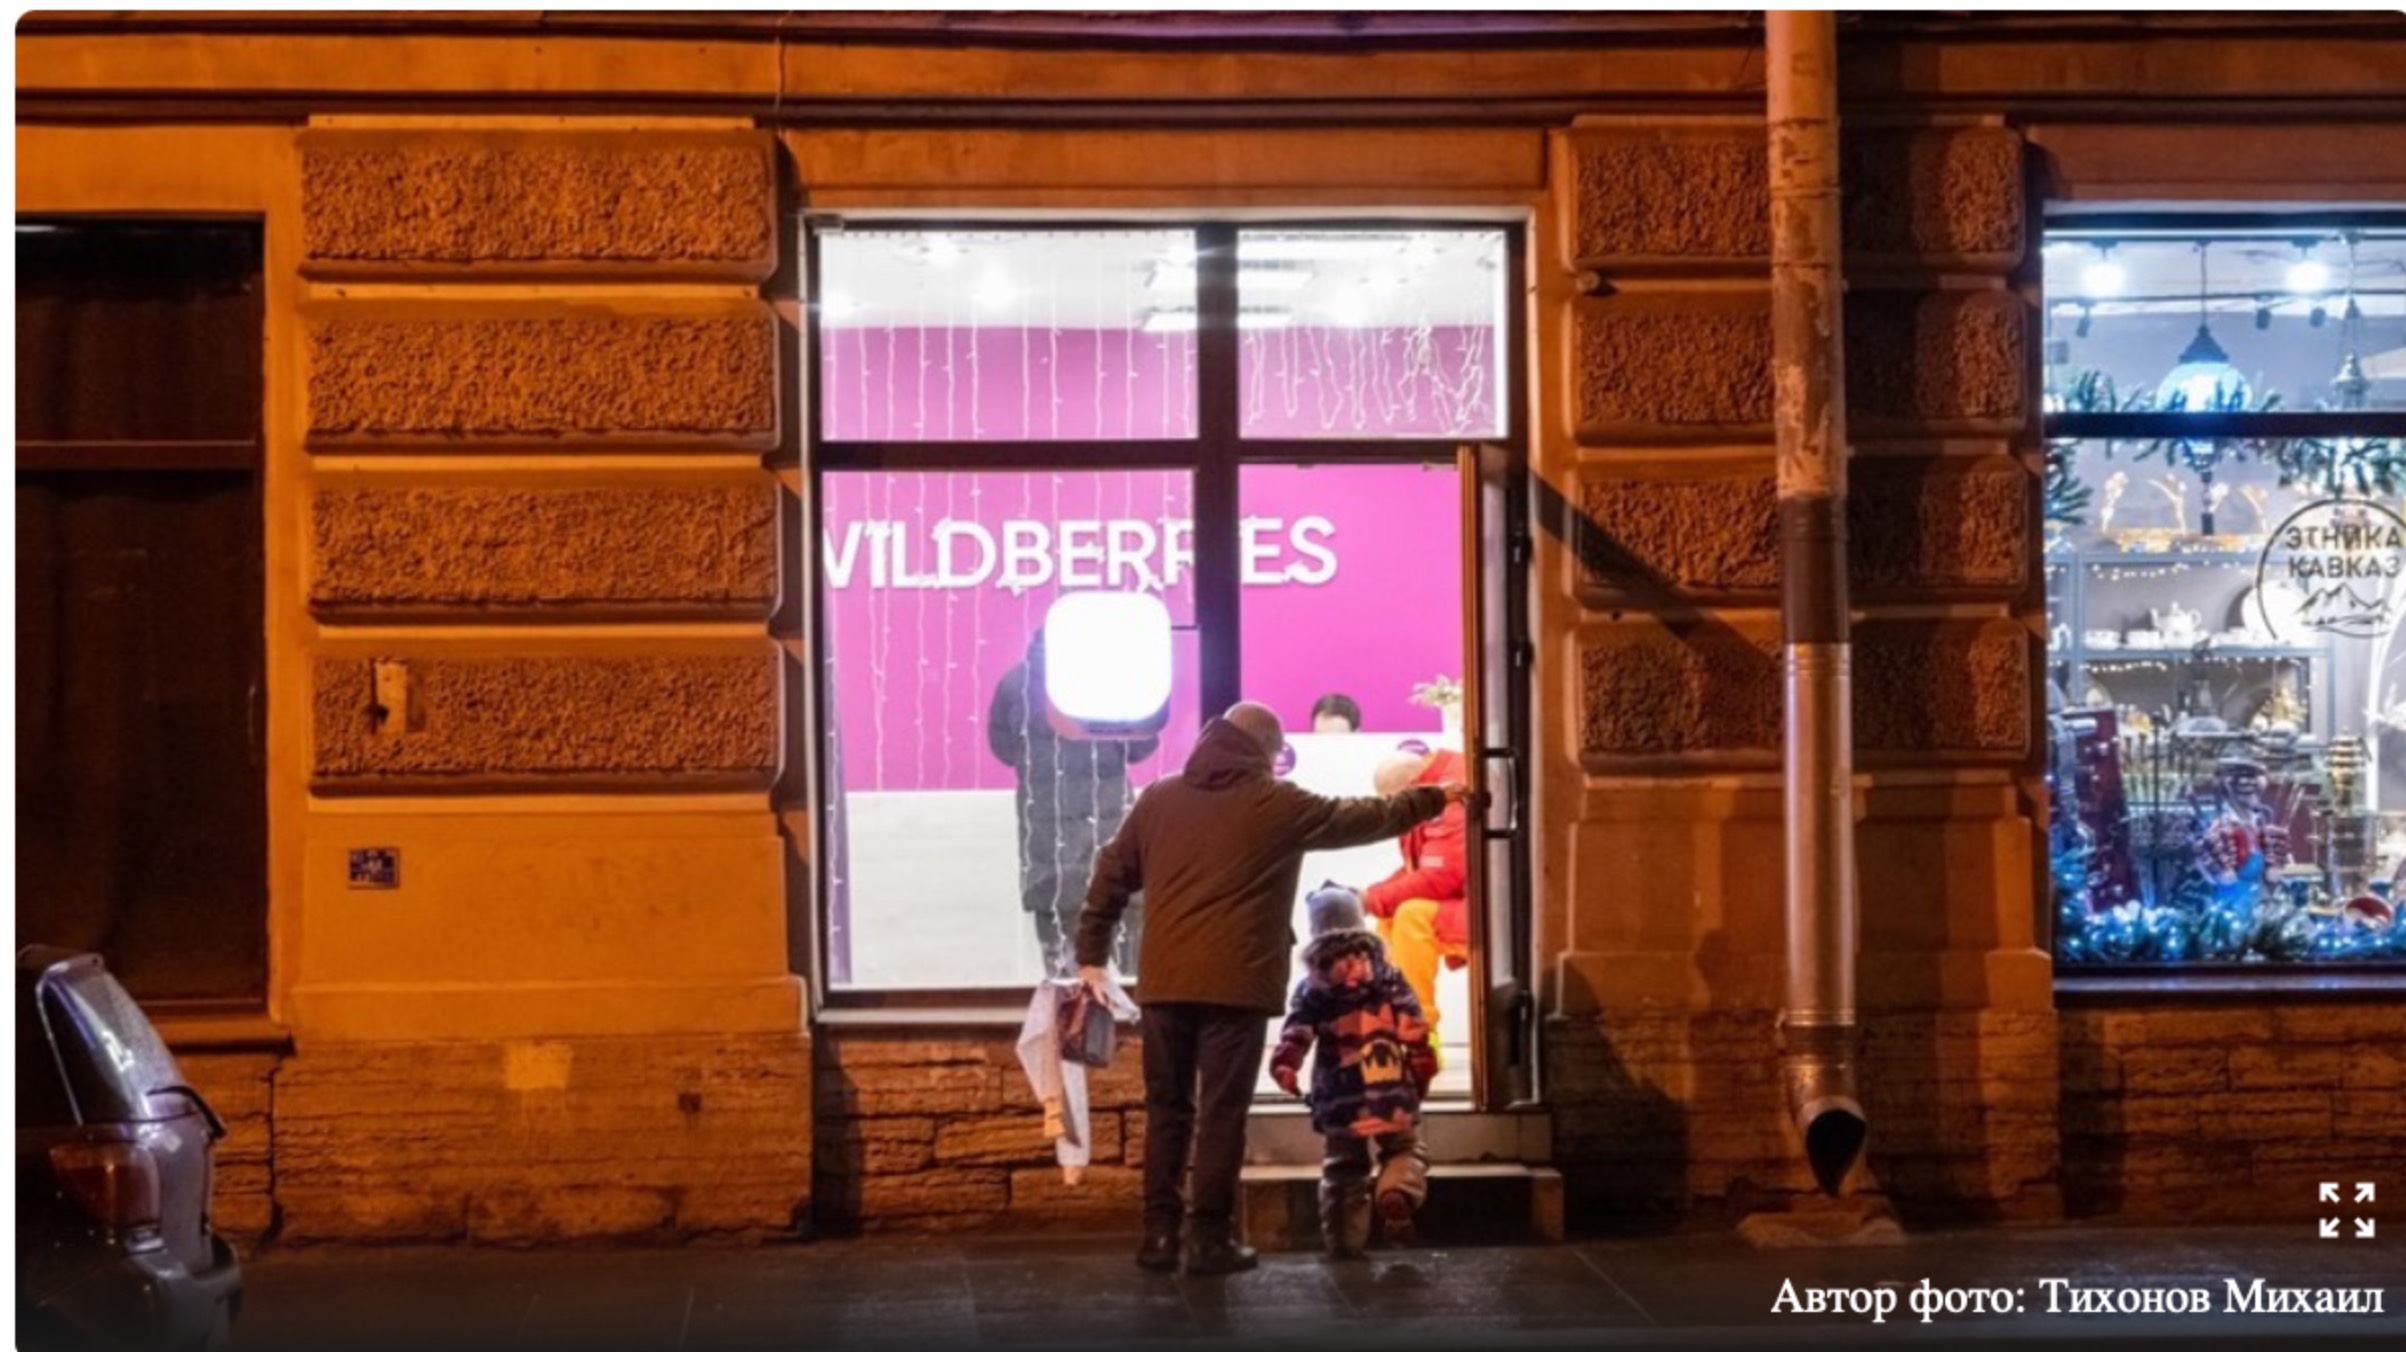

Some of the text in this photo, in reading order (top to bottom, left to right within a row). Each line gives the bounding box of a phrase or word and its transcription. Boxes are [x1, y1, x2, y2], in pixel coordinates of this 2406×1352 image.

[2286, 525, 2403, 550] ЭТНИКА
[823, 517, 1338, 589] ILDBERRES
[2288, 556, 2401, 578] КАВКАЗ
